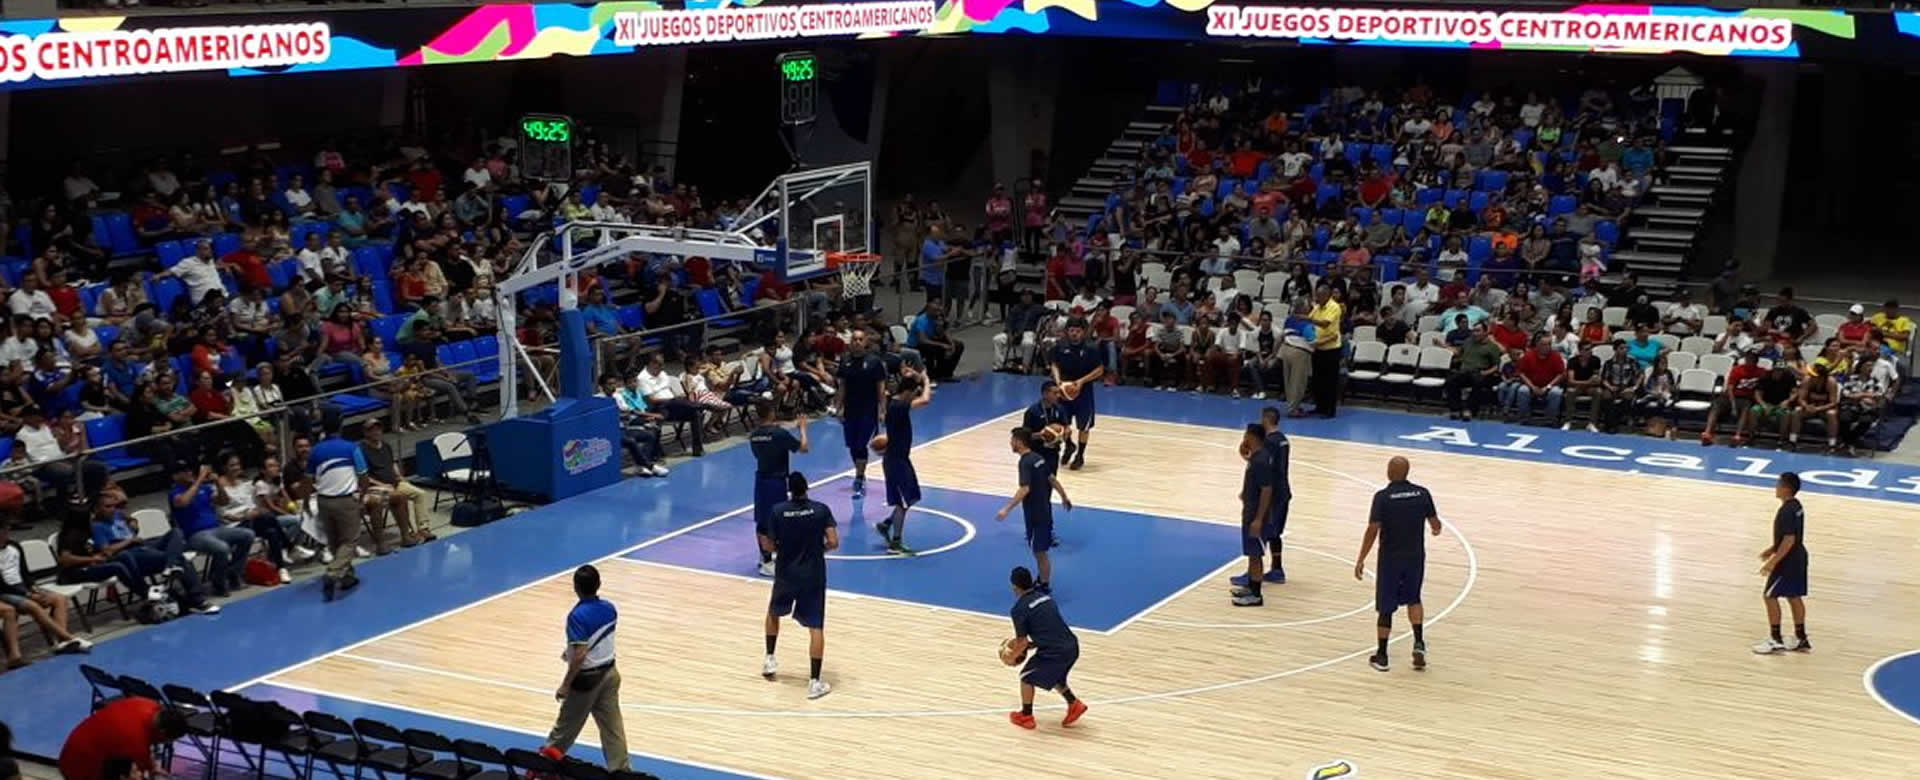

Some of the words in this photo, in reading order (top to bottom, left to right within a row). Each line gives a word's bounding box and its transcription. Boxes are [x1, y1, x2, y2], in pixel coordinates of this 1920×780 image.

[618, 18, 636, 40] XI
[641, 16, 701, 39] JUEGOS
[706, 12, 797, 35] DEPORTIVOS
[801, 6, 933, 31] CENTROAMERICANOS
[1212, 12, 1234, 30] XI
[1241, 13, 1330, 32] JUEGOS
[1337, 15, 1492, 36] DEPORTIVOS
[1500, 18, 1786, 45] CENTROAMERICANOS
[37, 30, 325, 71] CENTROAMERICANOS
[781, 59, 813, 81] 49:25
[523, 121, 567, 142] 49:25
